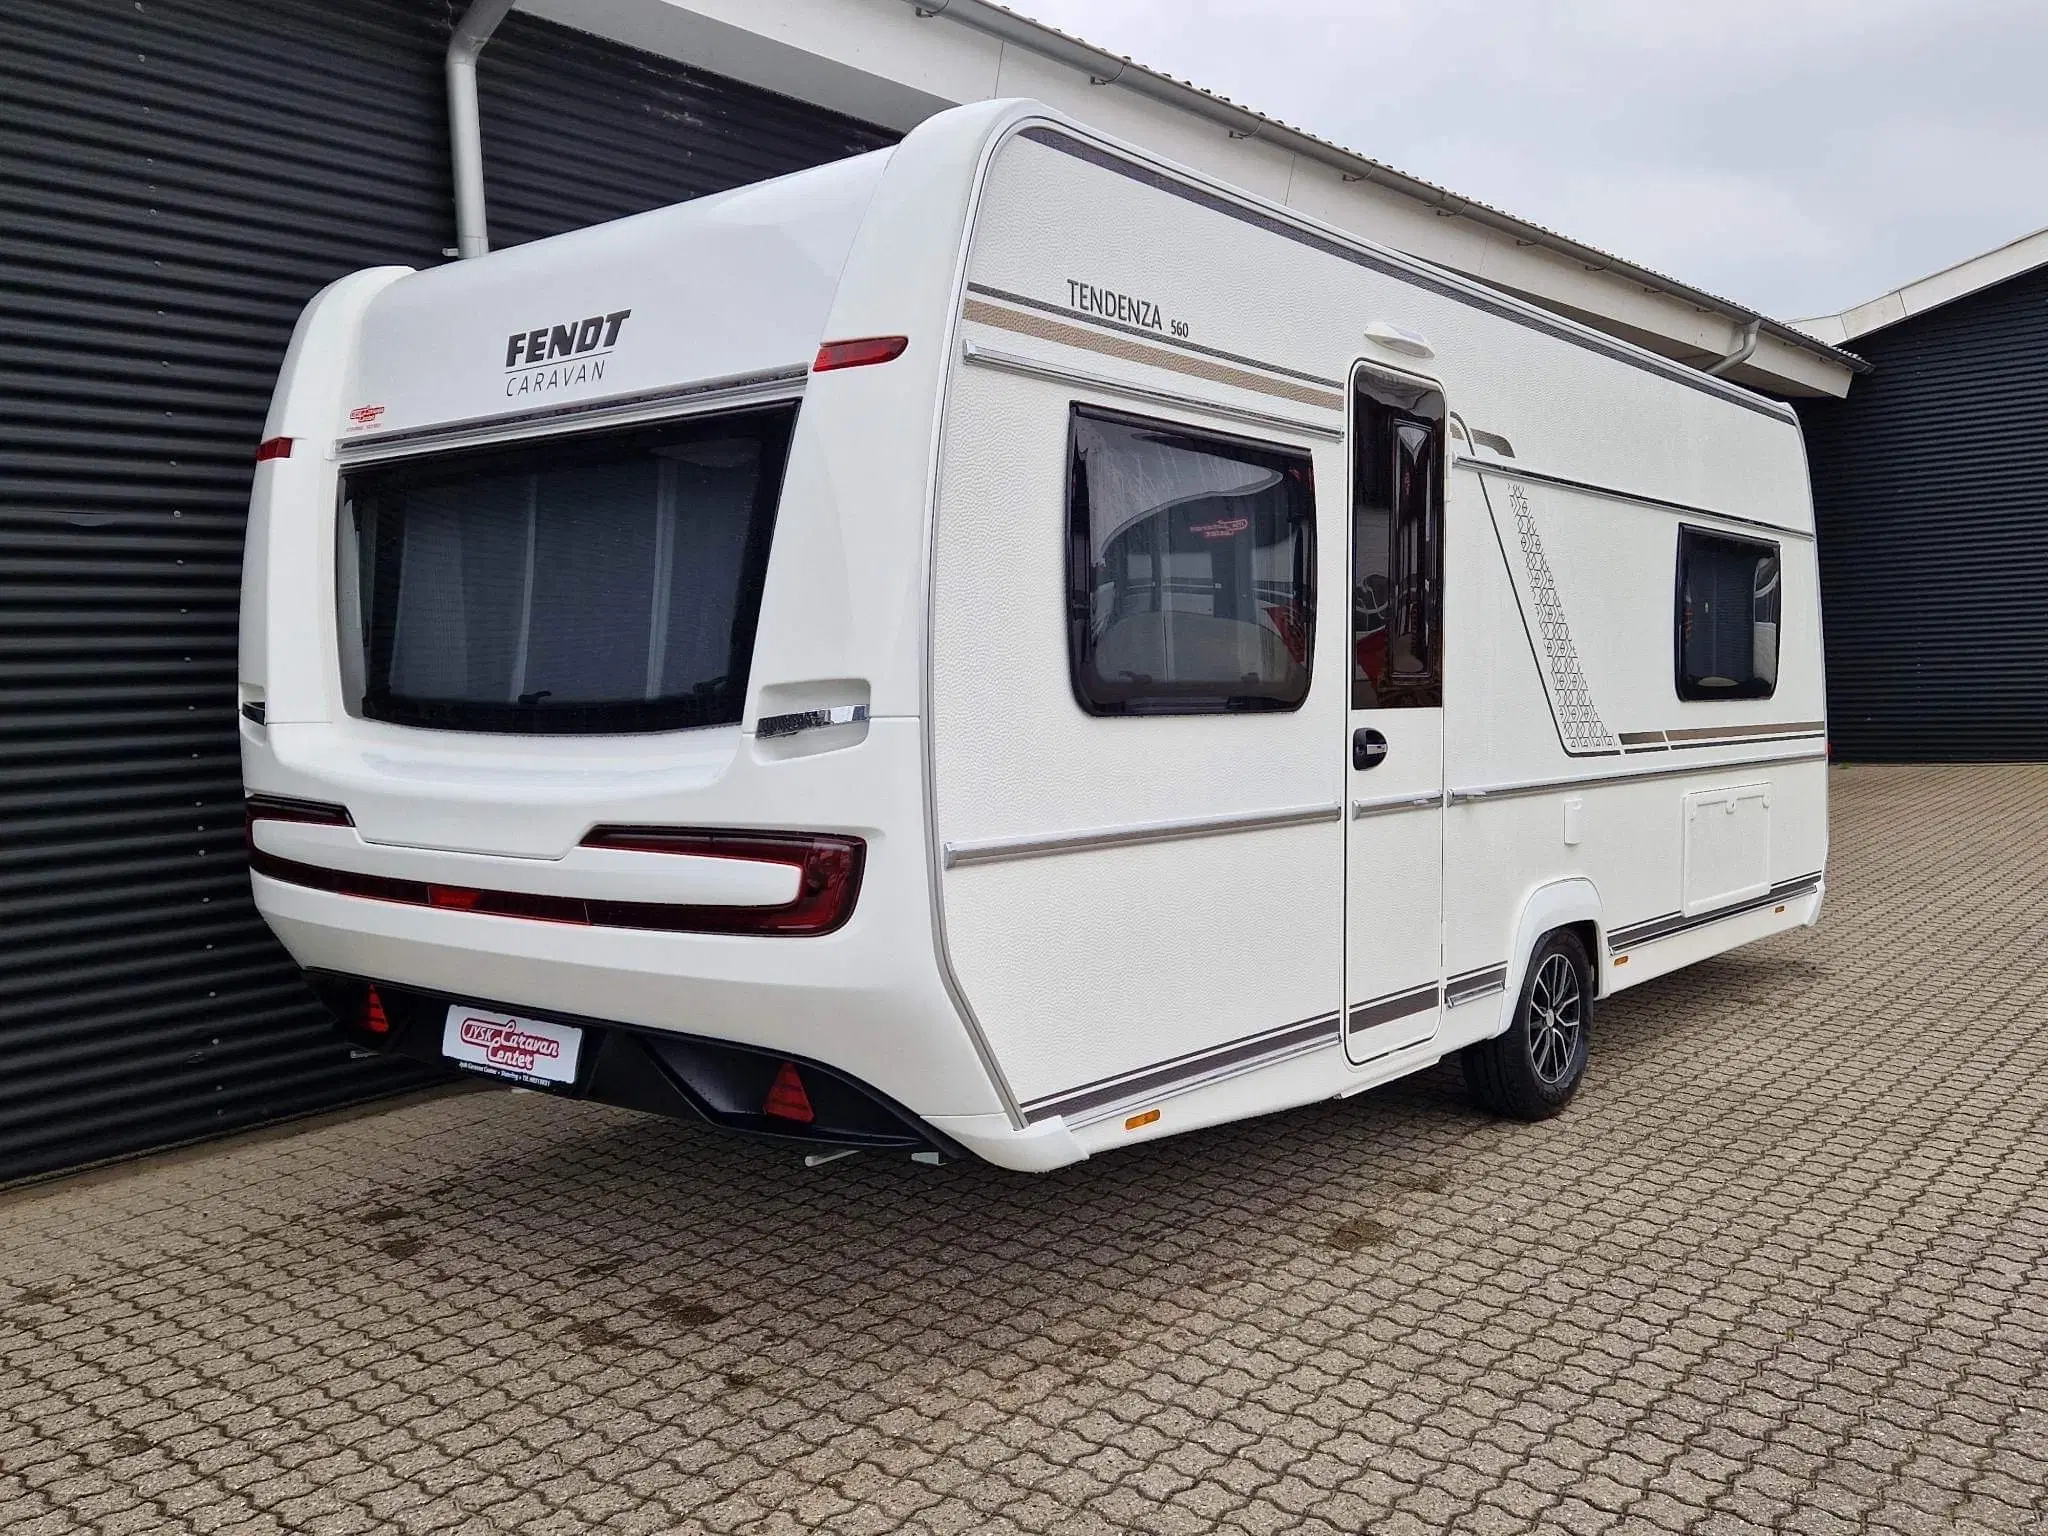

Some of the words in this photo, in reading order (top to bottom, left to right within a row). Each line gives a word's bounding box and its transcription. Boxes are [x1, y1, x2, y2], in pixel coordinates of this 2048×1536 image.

[1067, 279, 1162, 330] TENDENZA
[1170, 319, 1189, 338] 560
[505, 308, 632, 367] FENDT
[506, 360, 605, 397] CARAVAN
[467, 1024, 495, 1043] JYSK
[501, 1020, 559, 1057] Caravan
[488, 1036, 534, 1070] Center
